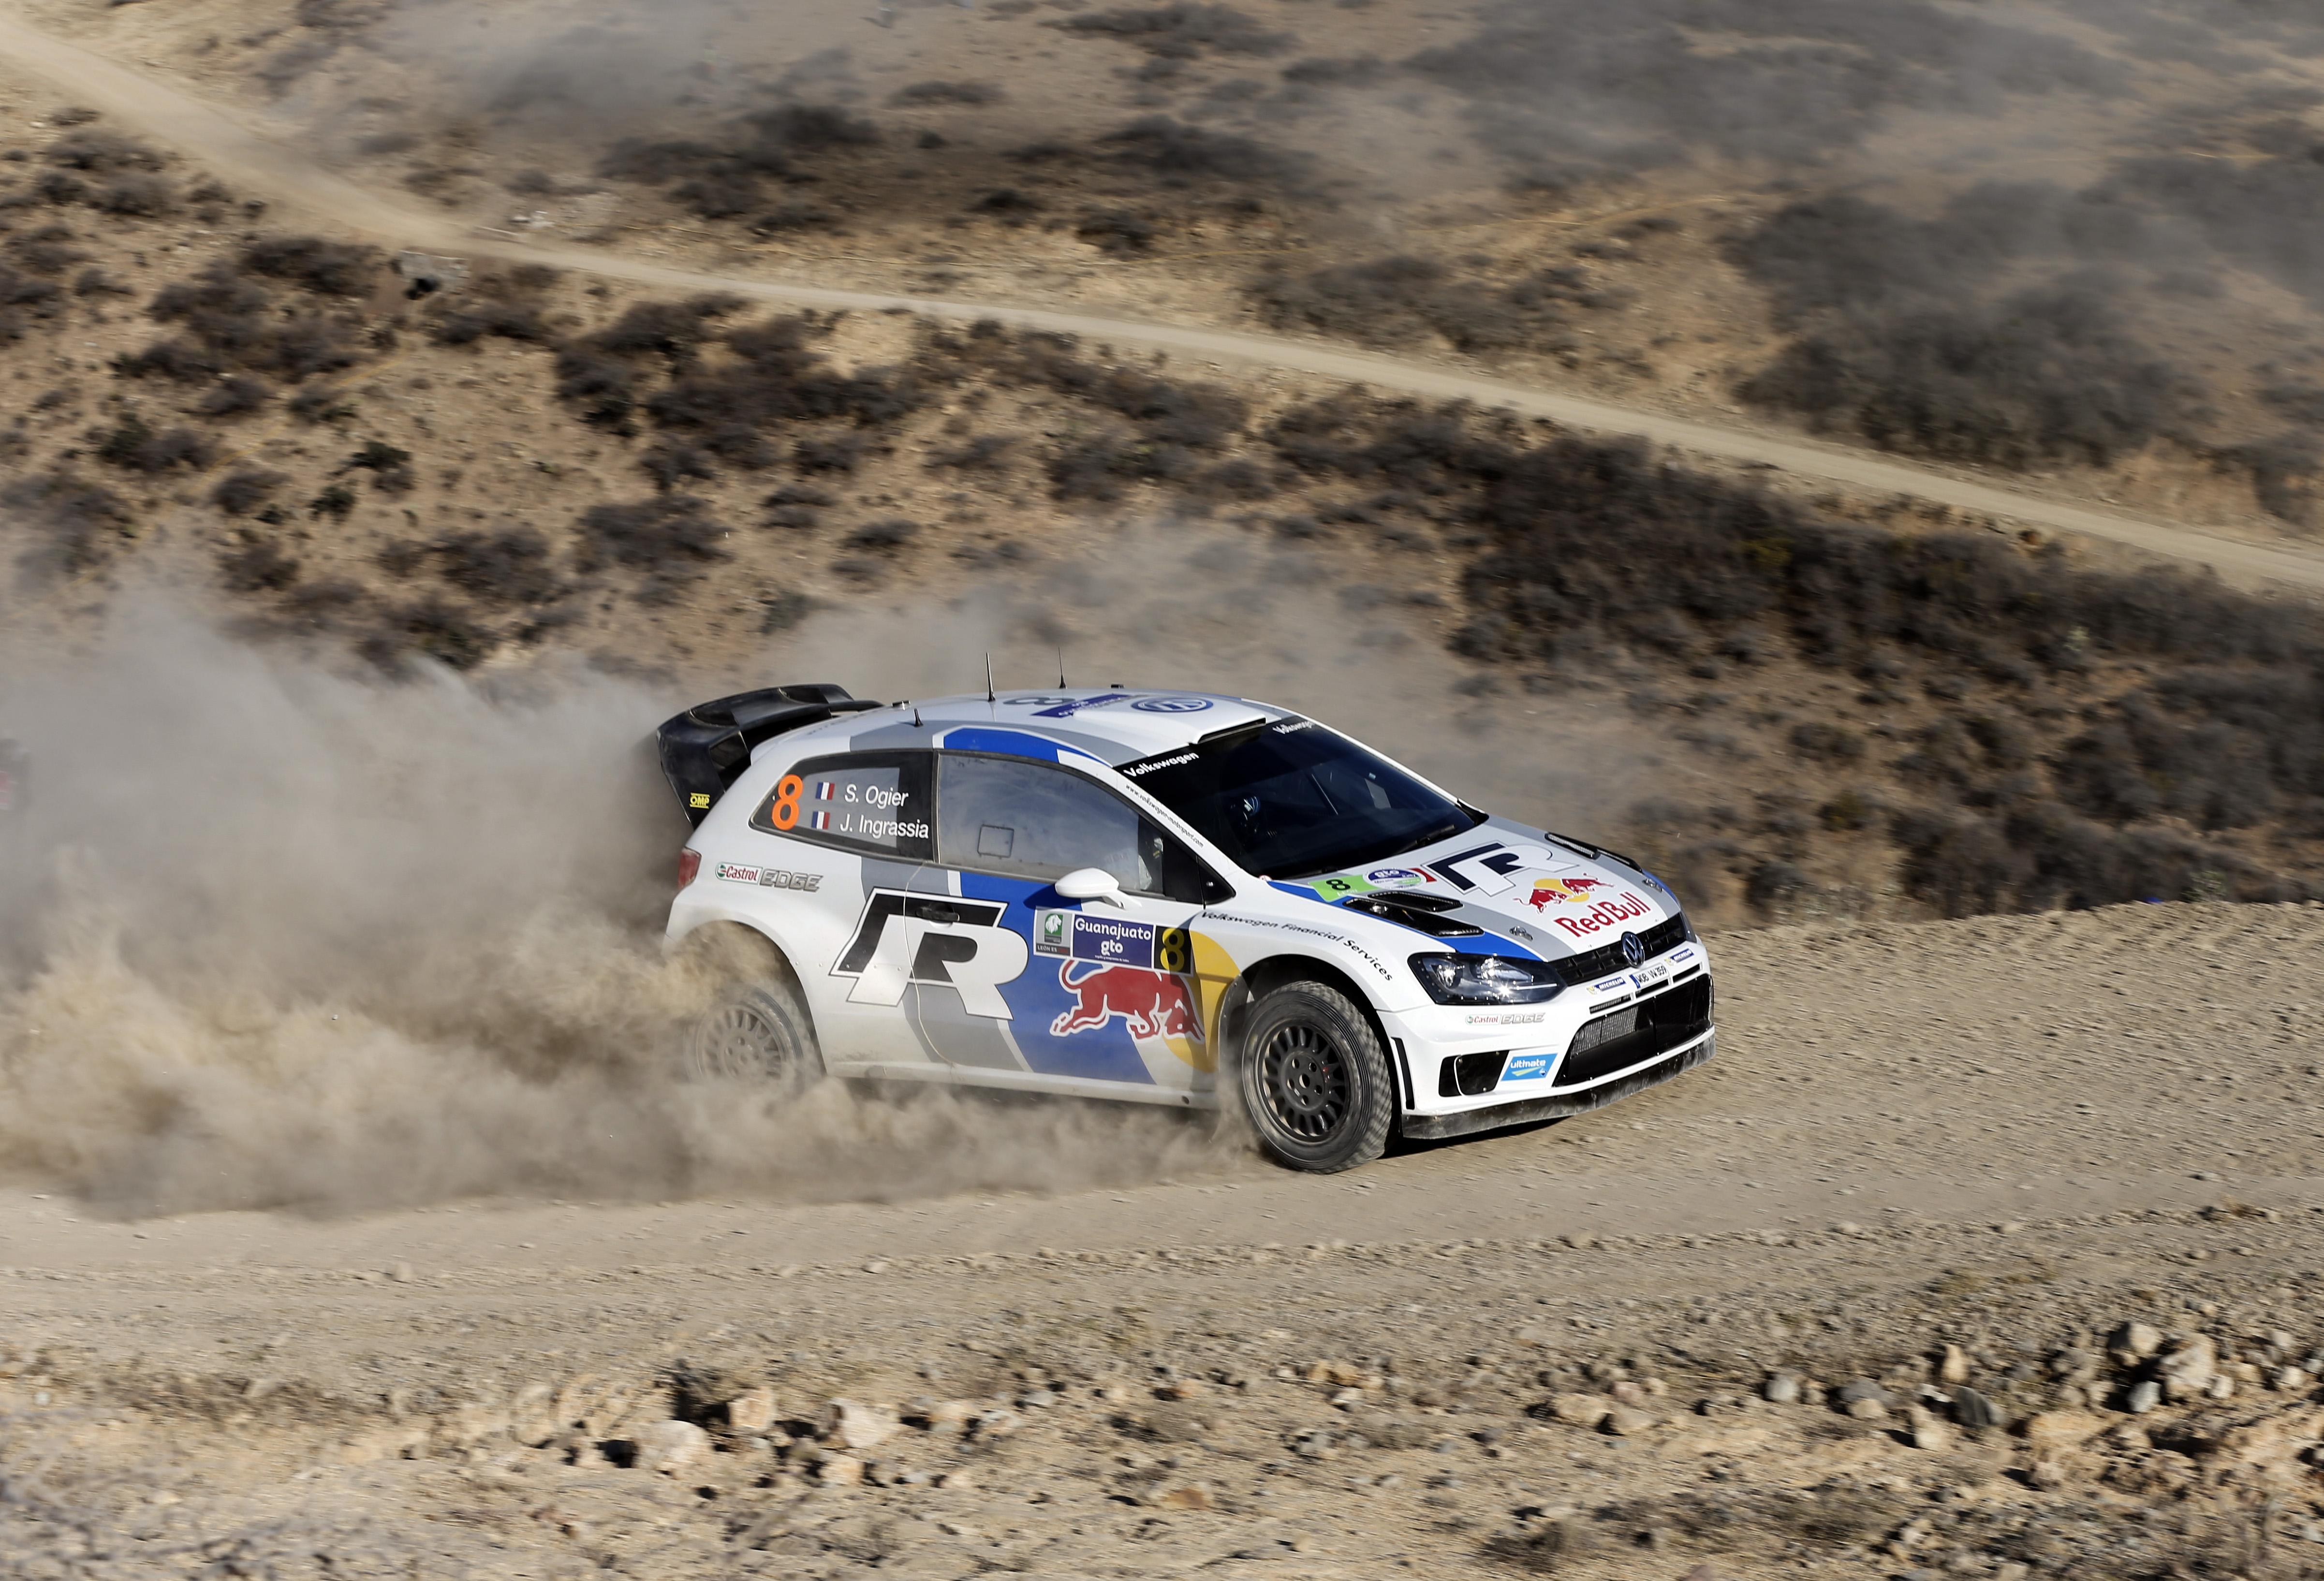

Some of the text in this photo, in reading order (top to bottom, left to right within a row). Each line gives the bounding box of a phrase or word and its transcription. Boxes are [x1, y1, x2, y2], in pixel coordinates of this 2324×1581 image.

[1123, 752, 1199, 776] Volkswagen
[690, 794, 710, 807] OMP
[771, 774, 804, 831] 8
[844, 783, 909, 810] S. Ogier
[839, 813, 929, 839] J. Ingrassia
[726, 865, 824, 893] Castrol EDGE
[1326, 879, 1351, 891] 8
[1075, 918, 1152, 941] Guanajuato
[1101, 939, 1124, 956] gto
[1160, 927, 1185, 972] 8
[1202, 911, 1393, 982] Volkswagen Financial Services
[1599, 978, 1624, 990] MICHELIN
[1474, 1012, 1546, 1025] Castrol EDGE
[1510, 1058, 1546, 1069] ultimate
